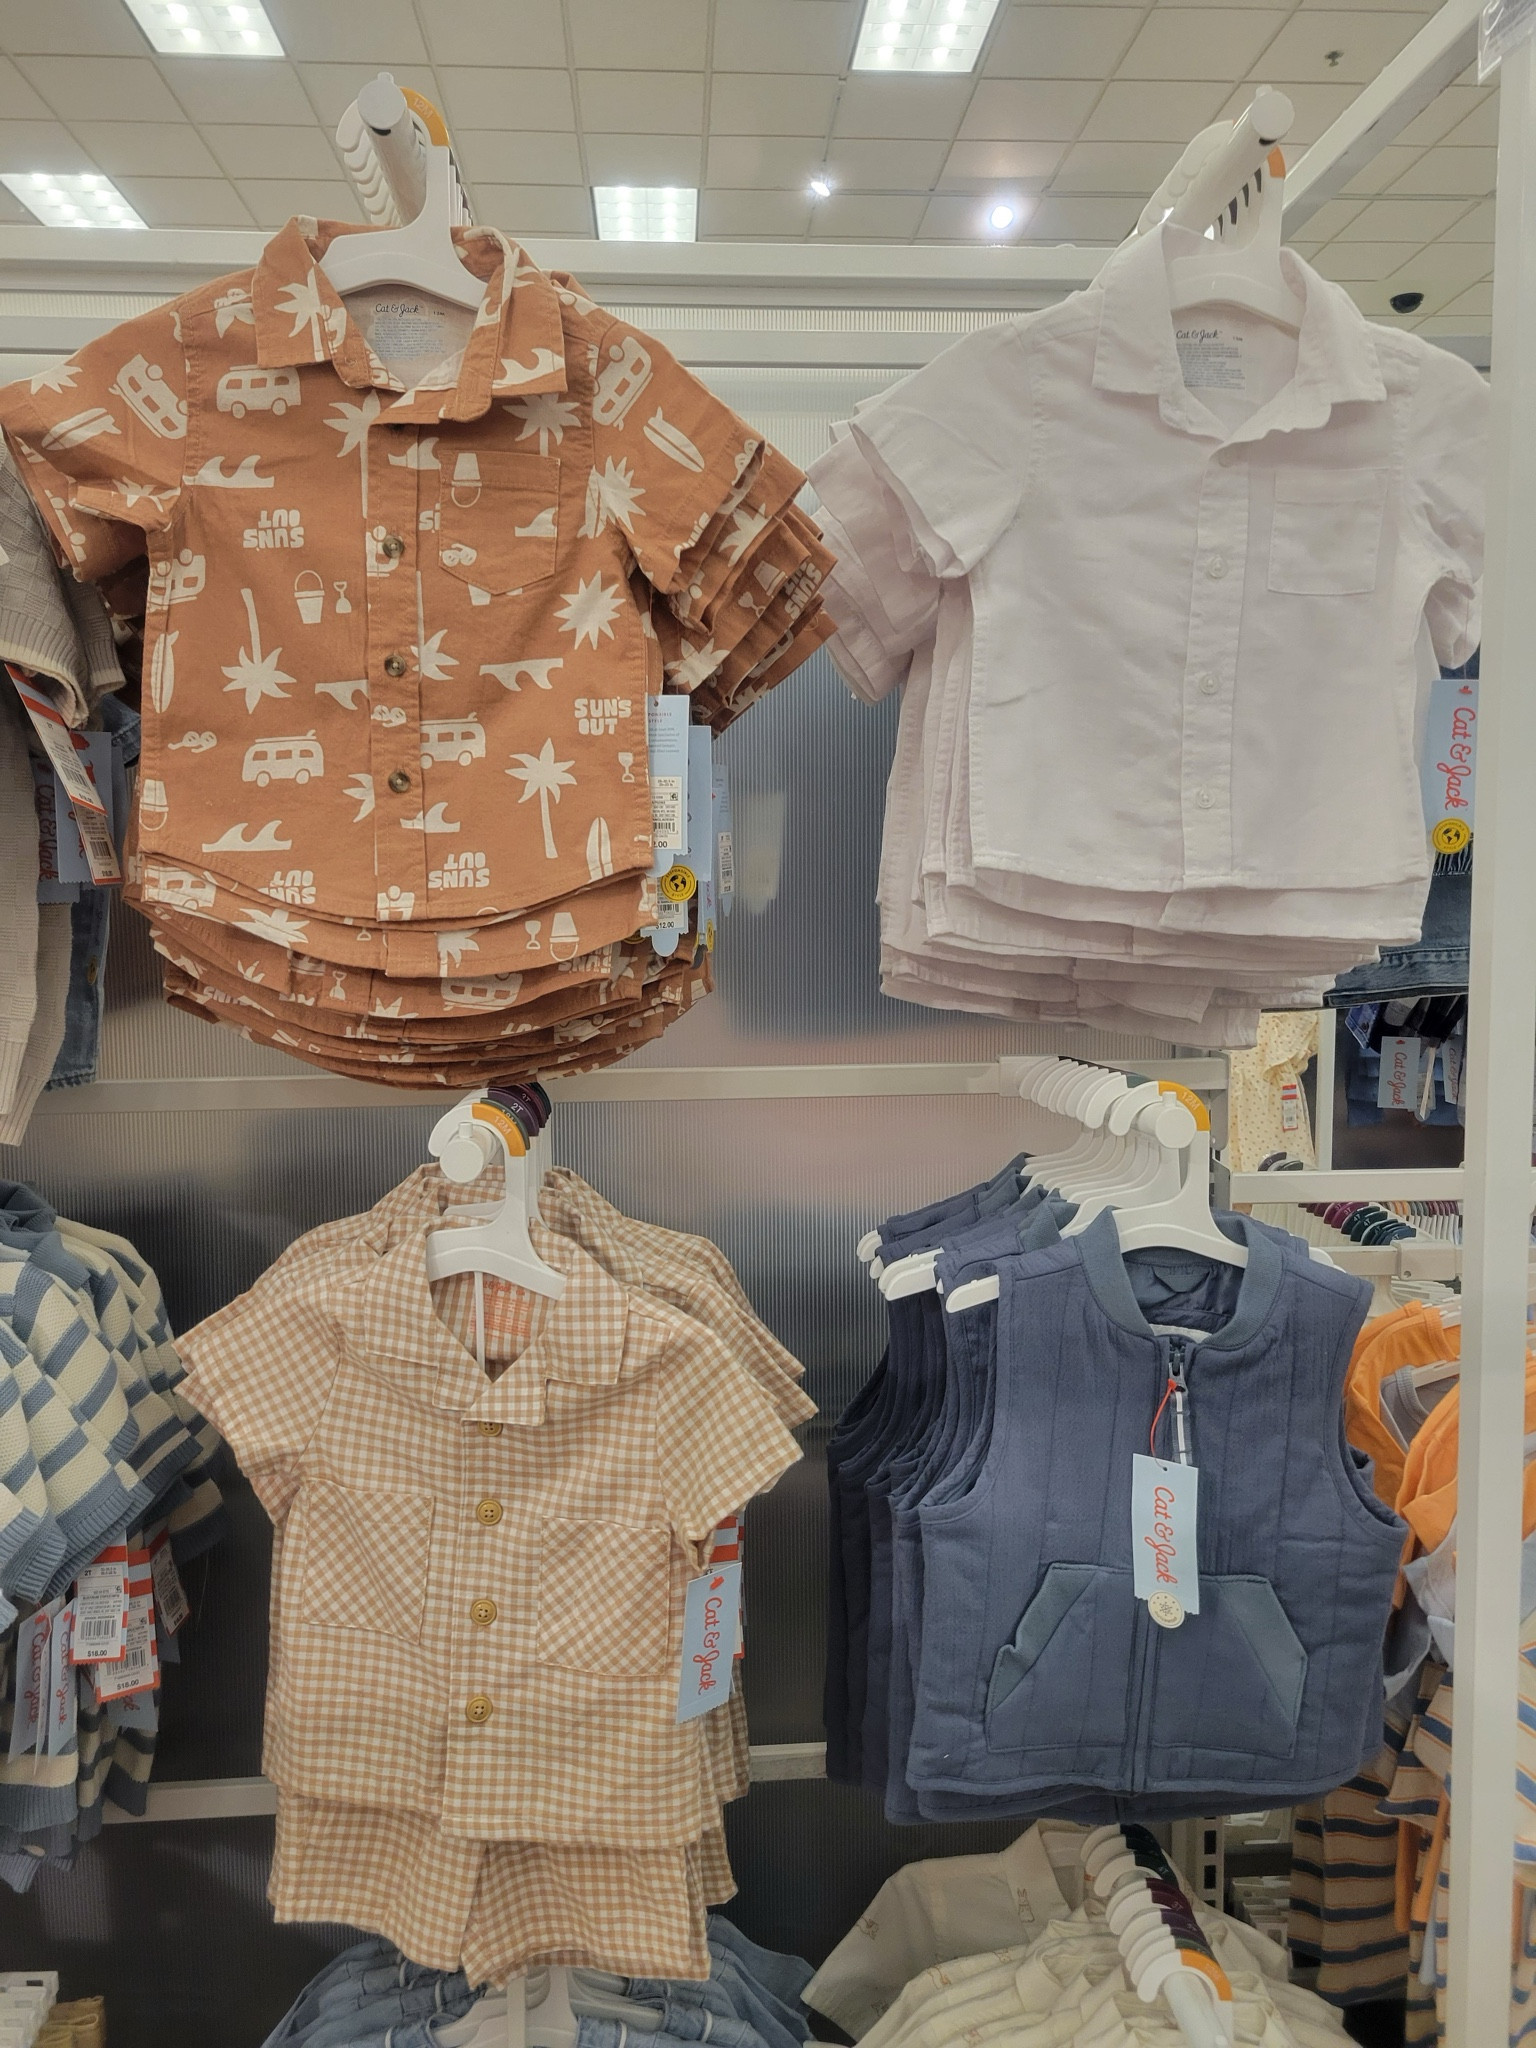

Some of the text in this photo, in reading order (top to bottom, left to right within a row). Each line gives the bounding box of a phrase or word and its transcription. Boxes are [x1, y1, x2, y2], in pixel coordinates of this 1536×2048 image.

[375, 303, 419, 317] Cat & Jack
[1175, 328, 1218, 344] Cat & Jack
[257, 508, 301, 528] OUT
[242, 526, 305, 552] SUN'S
[574, 696, 633, 719] SUN'S
[579, 717, 619, 736] OUT
[1437, 707, 1476, 811] Cat & Jack
[36, 784, 55, 818] Cat
[443, 851, 487, 870] OUT
[270, 870, 315, 887] OUT
[428, 868, 491, 891] SUN'S
[1394, 1051, 1408, 1069] Cat
[1386, 1080, 1407, 1106] Jack
[510, 1102, 524, 1114] 2T
[493, 1115, 513, 1135] 12M
[1352, 1212, 1361, 1222] 4T
[1362, 1217, 1371, 1227] 4T
[1153, 1485, 1176, 1521] Cat
[1154, 1522, 1174, 1542] &
[1144, 1535, 1179, 1584] Jack
[84, 1569, 92, 1577] 2T
[705, 1596, 723, 1631] Cat
[31, 1631, 48, 1663] Cat
[703, 1631, 721, 1649] &
[693, 1649, 720, 1695] Jack
